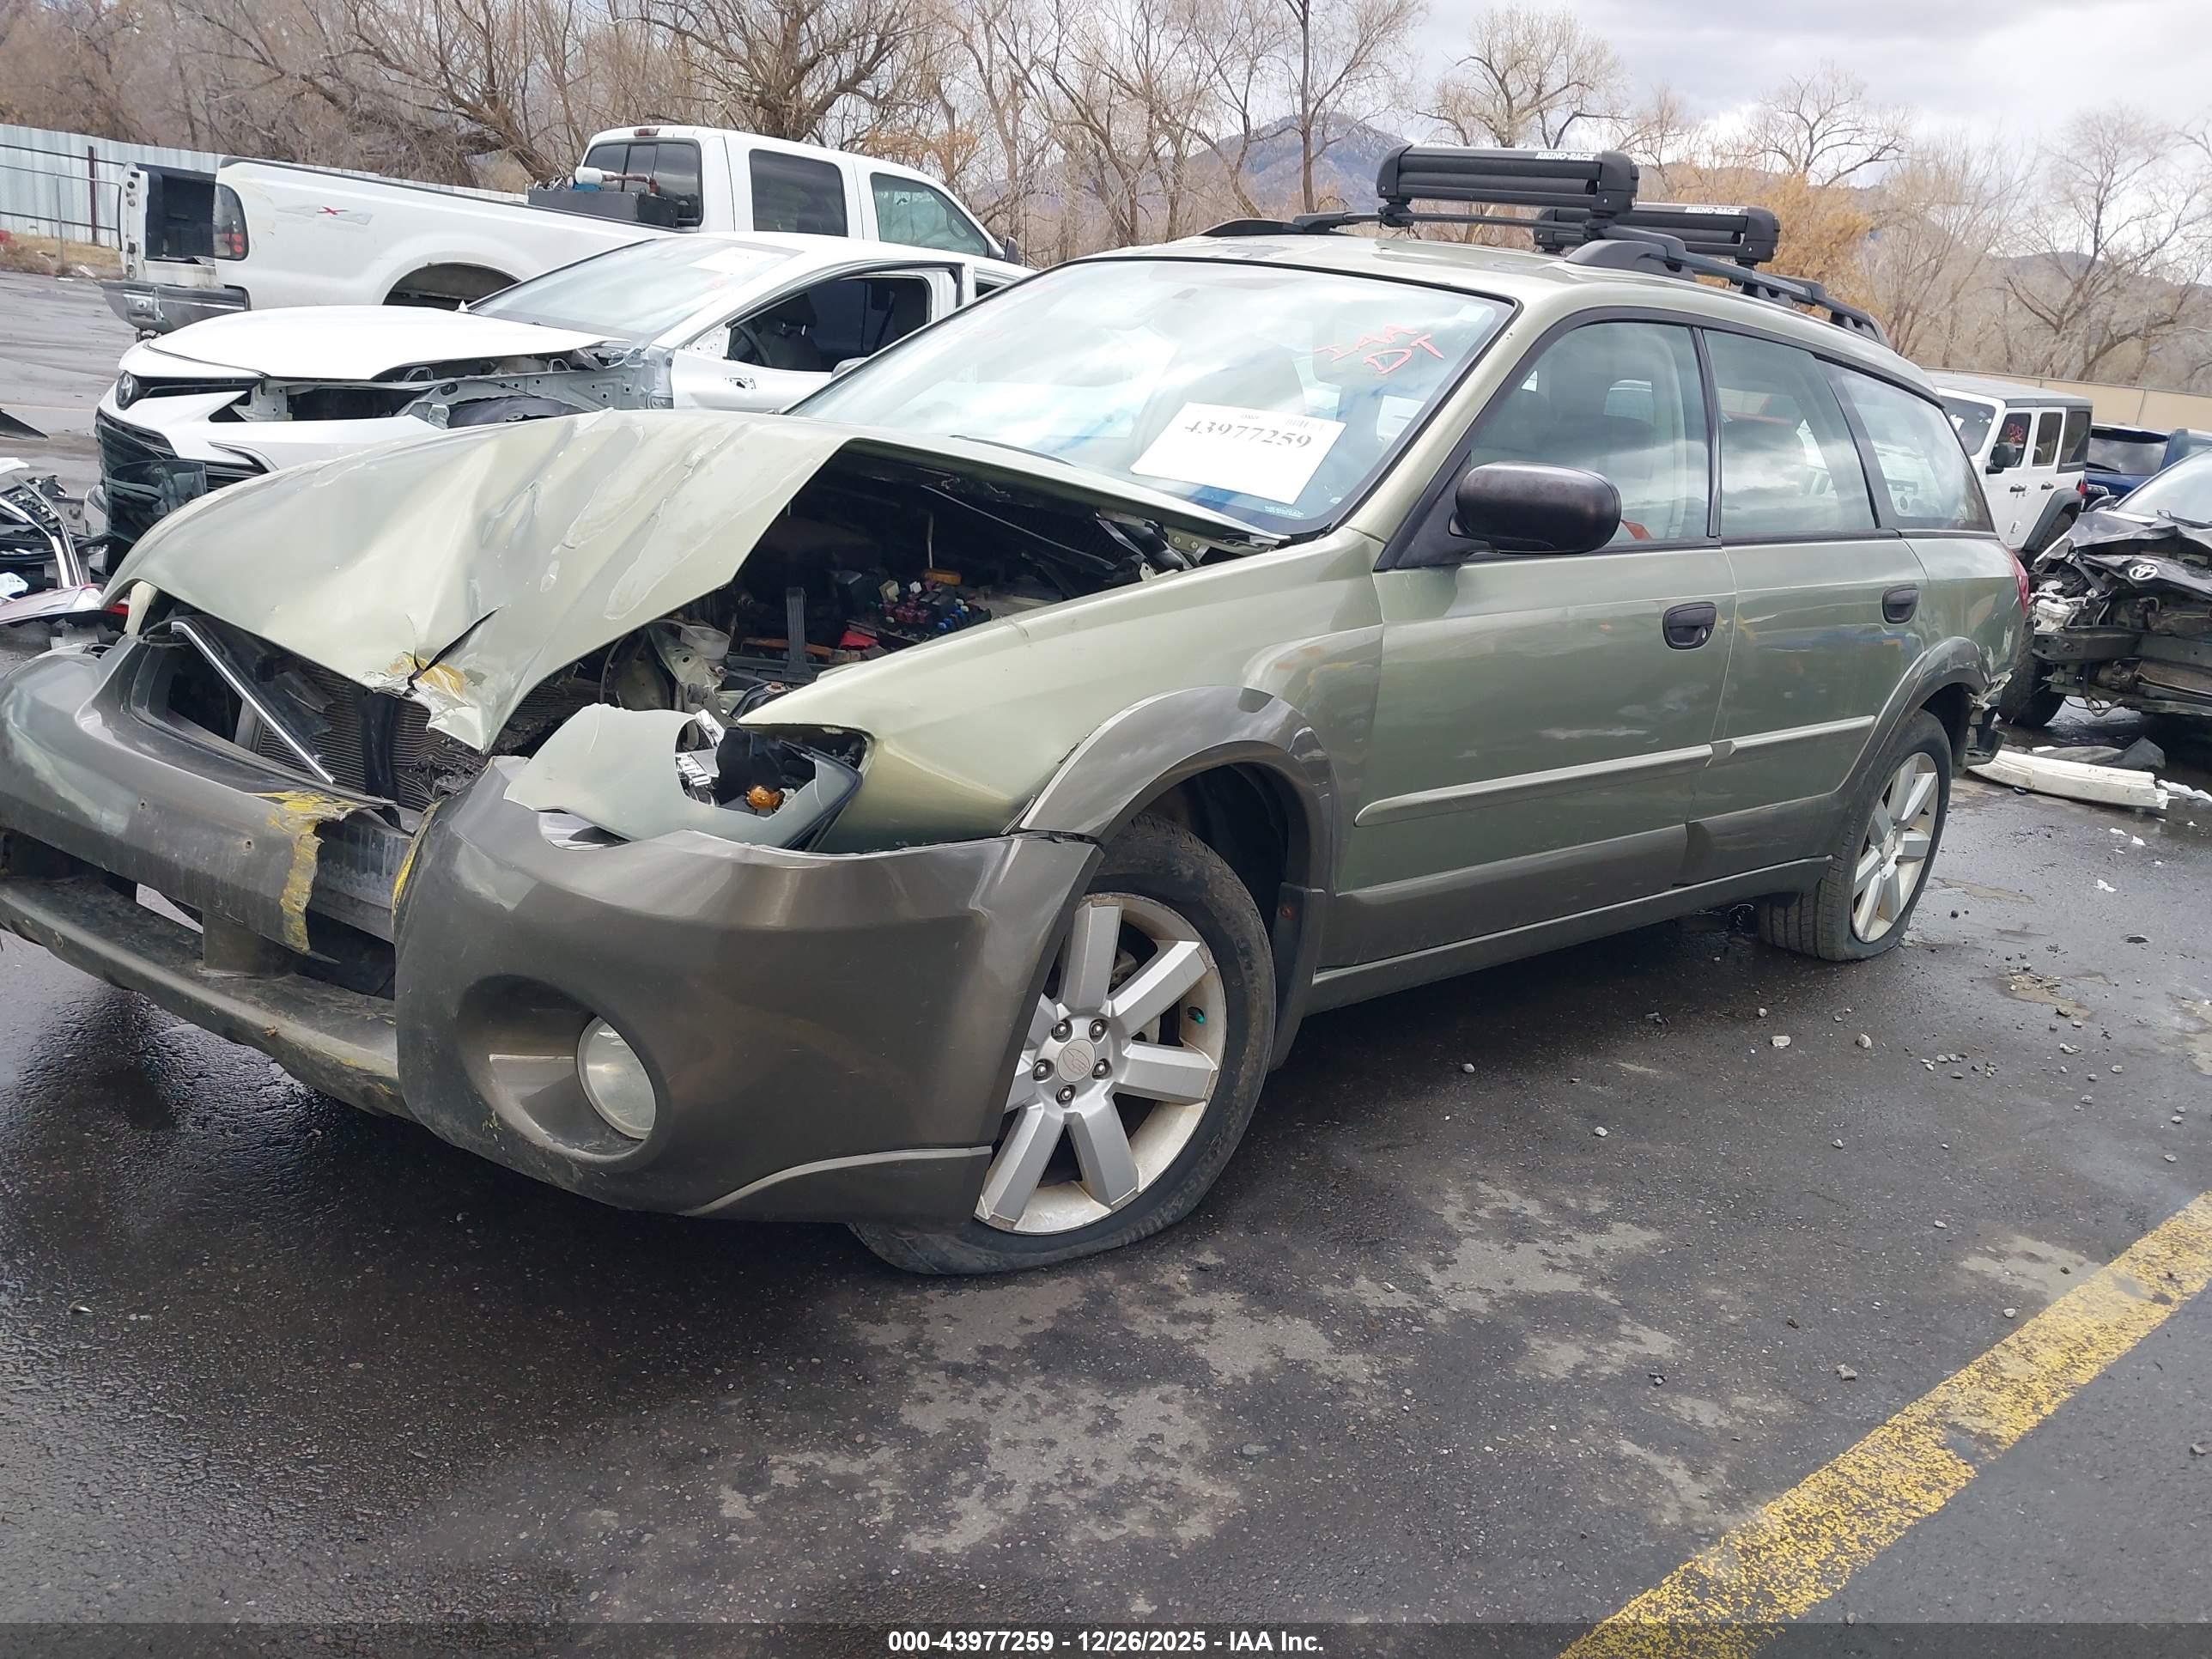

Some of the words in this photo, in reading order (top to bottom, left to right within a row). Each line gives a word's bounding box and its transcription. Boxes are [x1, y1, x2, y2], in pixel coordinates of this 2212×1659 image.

[1534, 151, 1595, 161] RHINO-RACK
[1684, 205, 1741, 216] RHINO-RACK
[1184, 419, 1312, 448] 43977259
